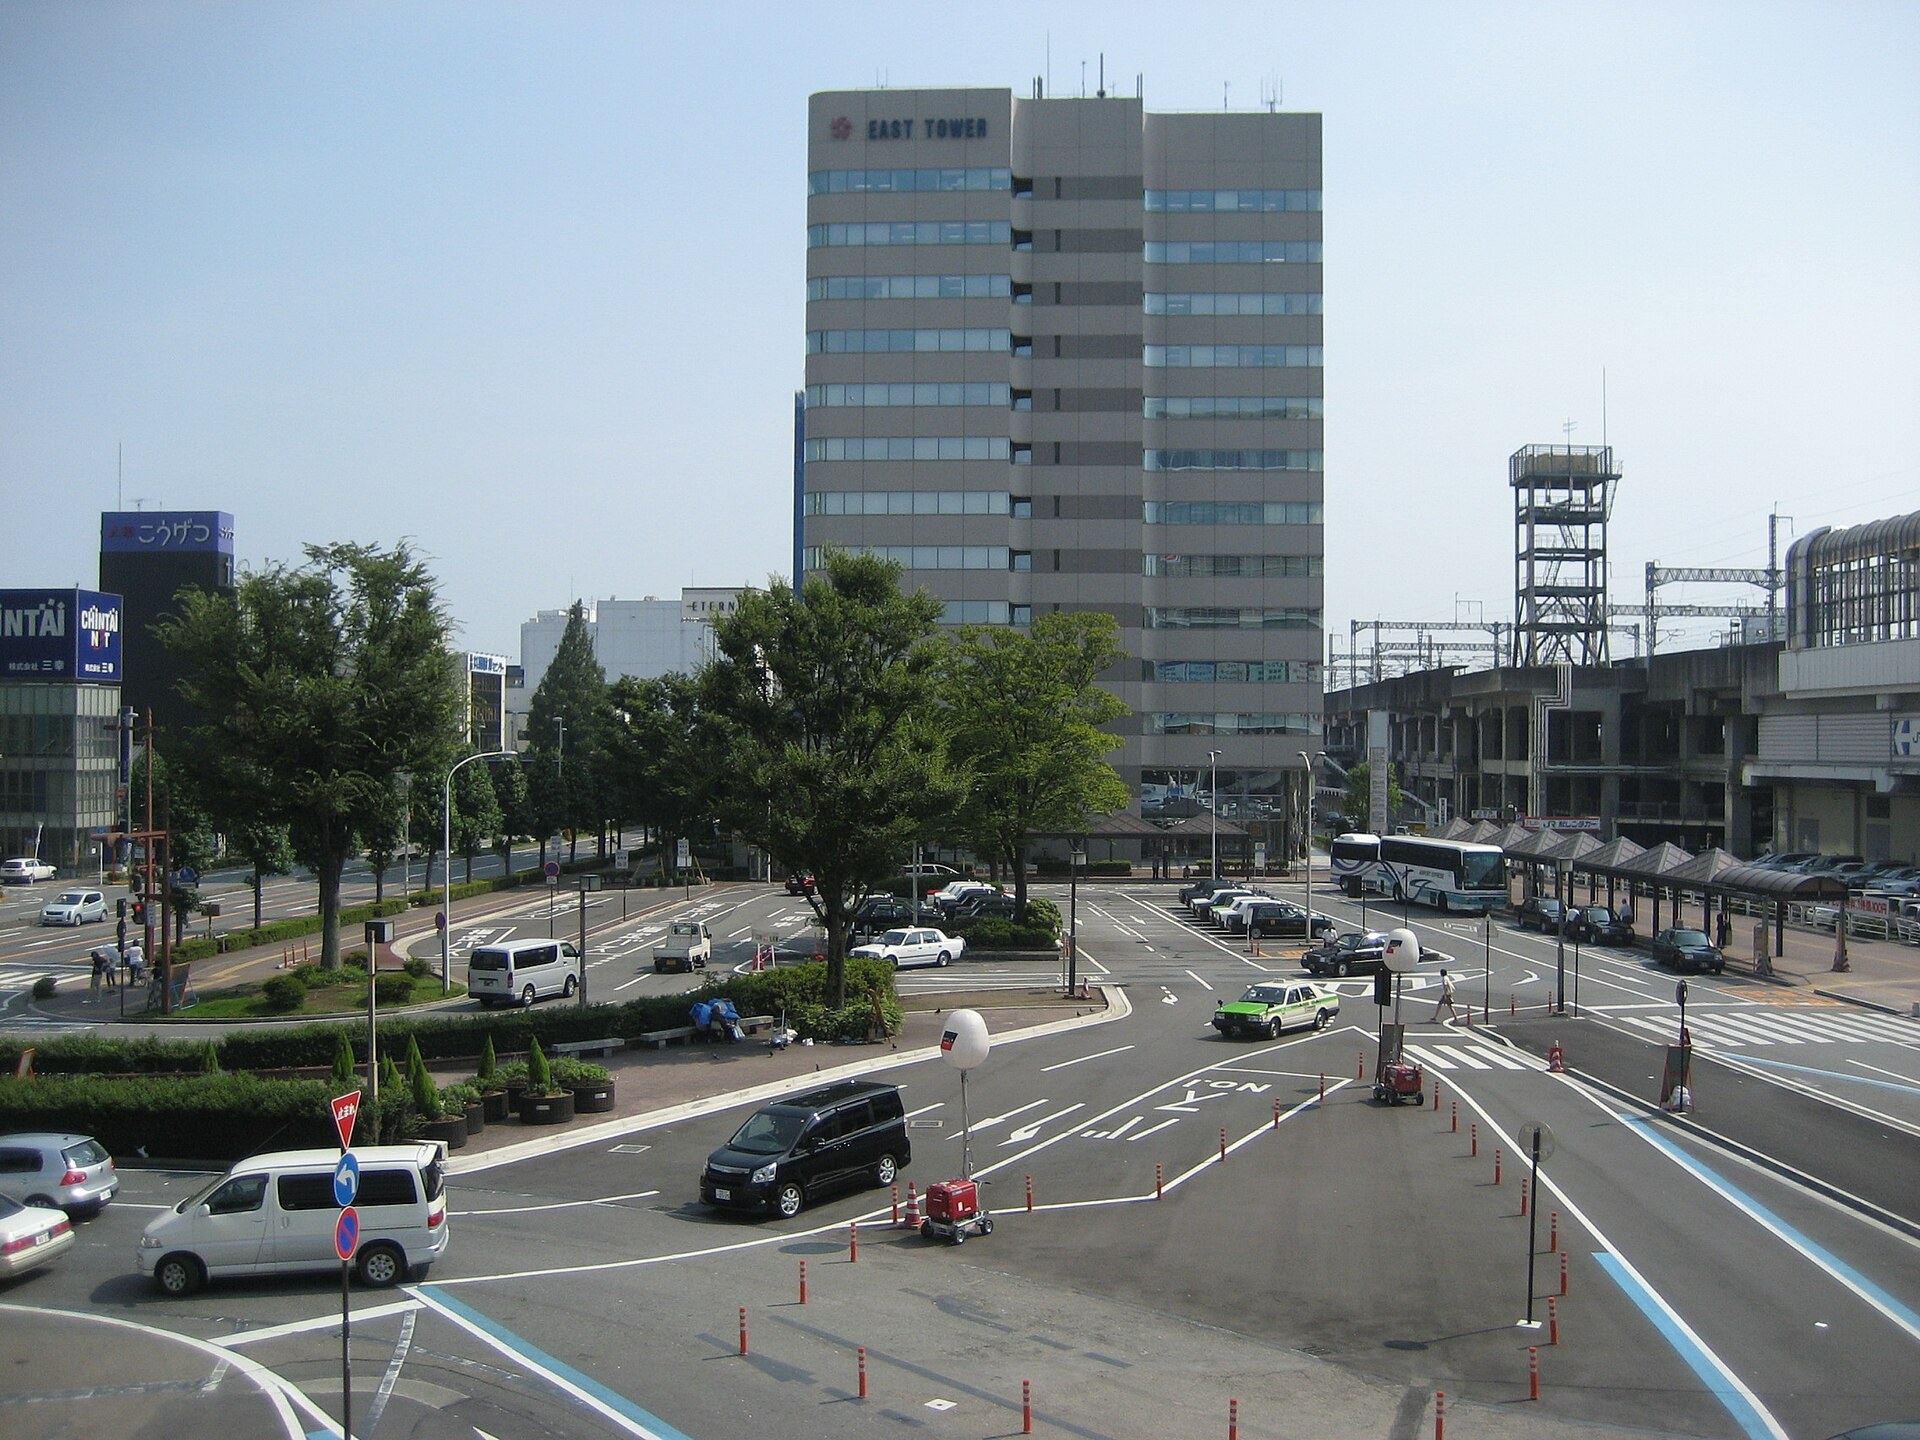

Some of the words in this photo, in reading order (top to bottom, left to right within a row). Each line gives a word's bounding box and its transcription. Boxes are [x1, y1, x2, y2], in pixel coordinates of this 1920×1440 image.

[868, 119, 914, 140] EAST
[924, 118, 987, 139] TOWER
[138, 518, 210, 546] こうげつ
[81, 605, 119, 632] CHINTAI
[337, 1103, 357, 1120] 止まれ
